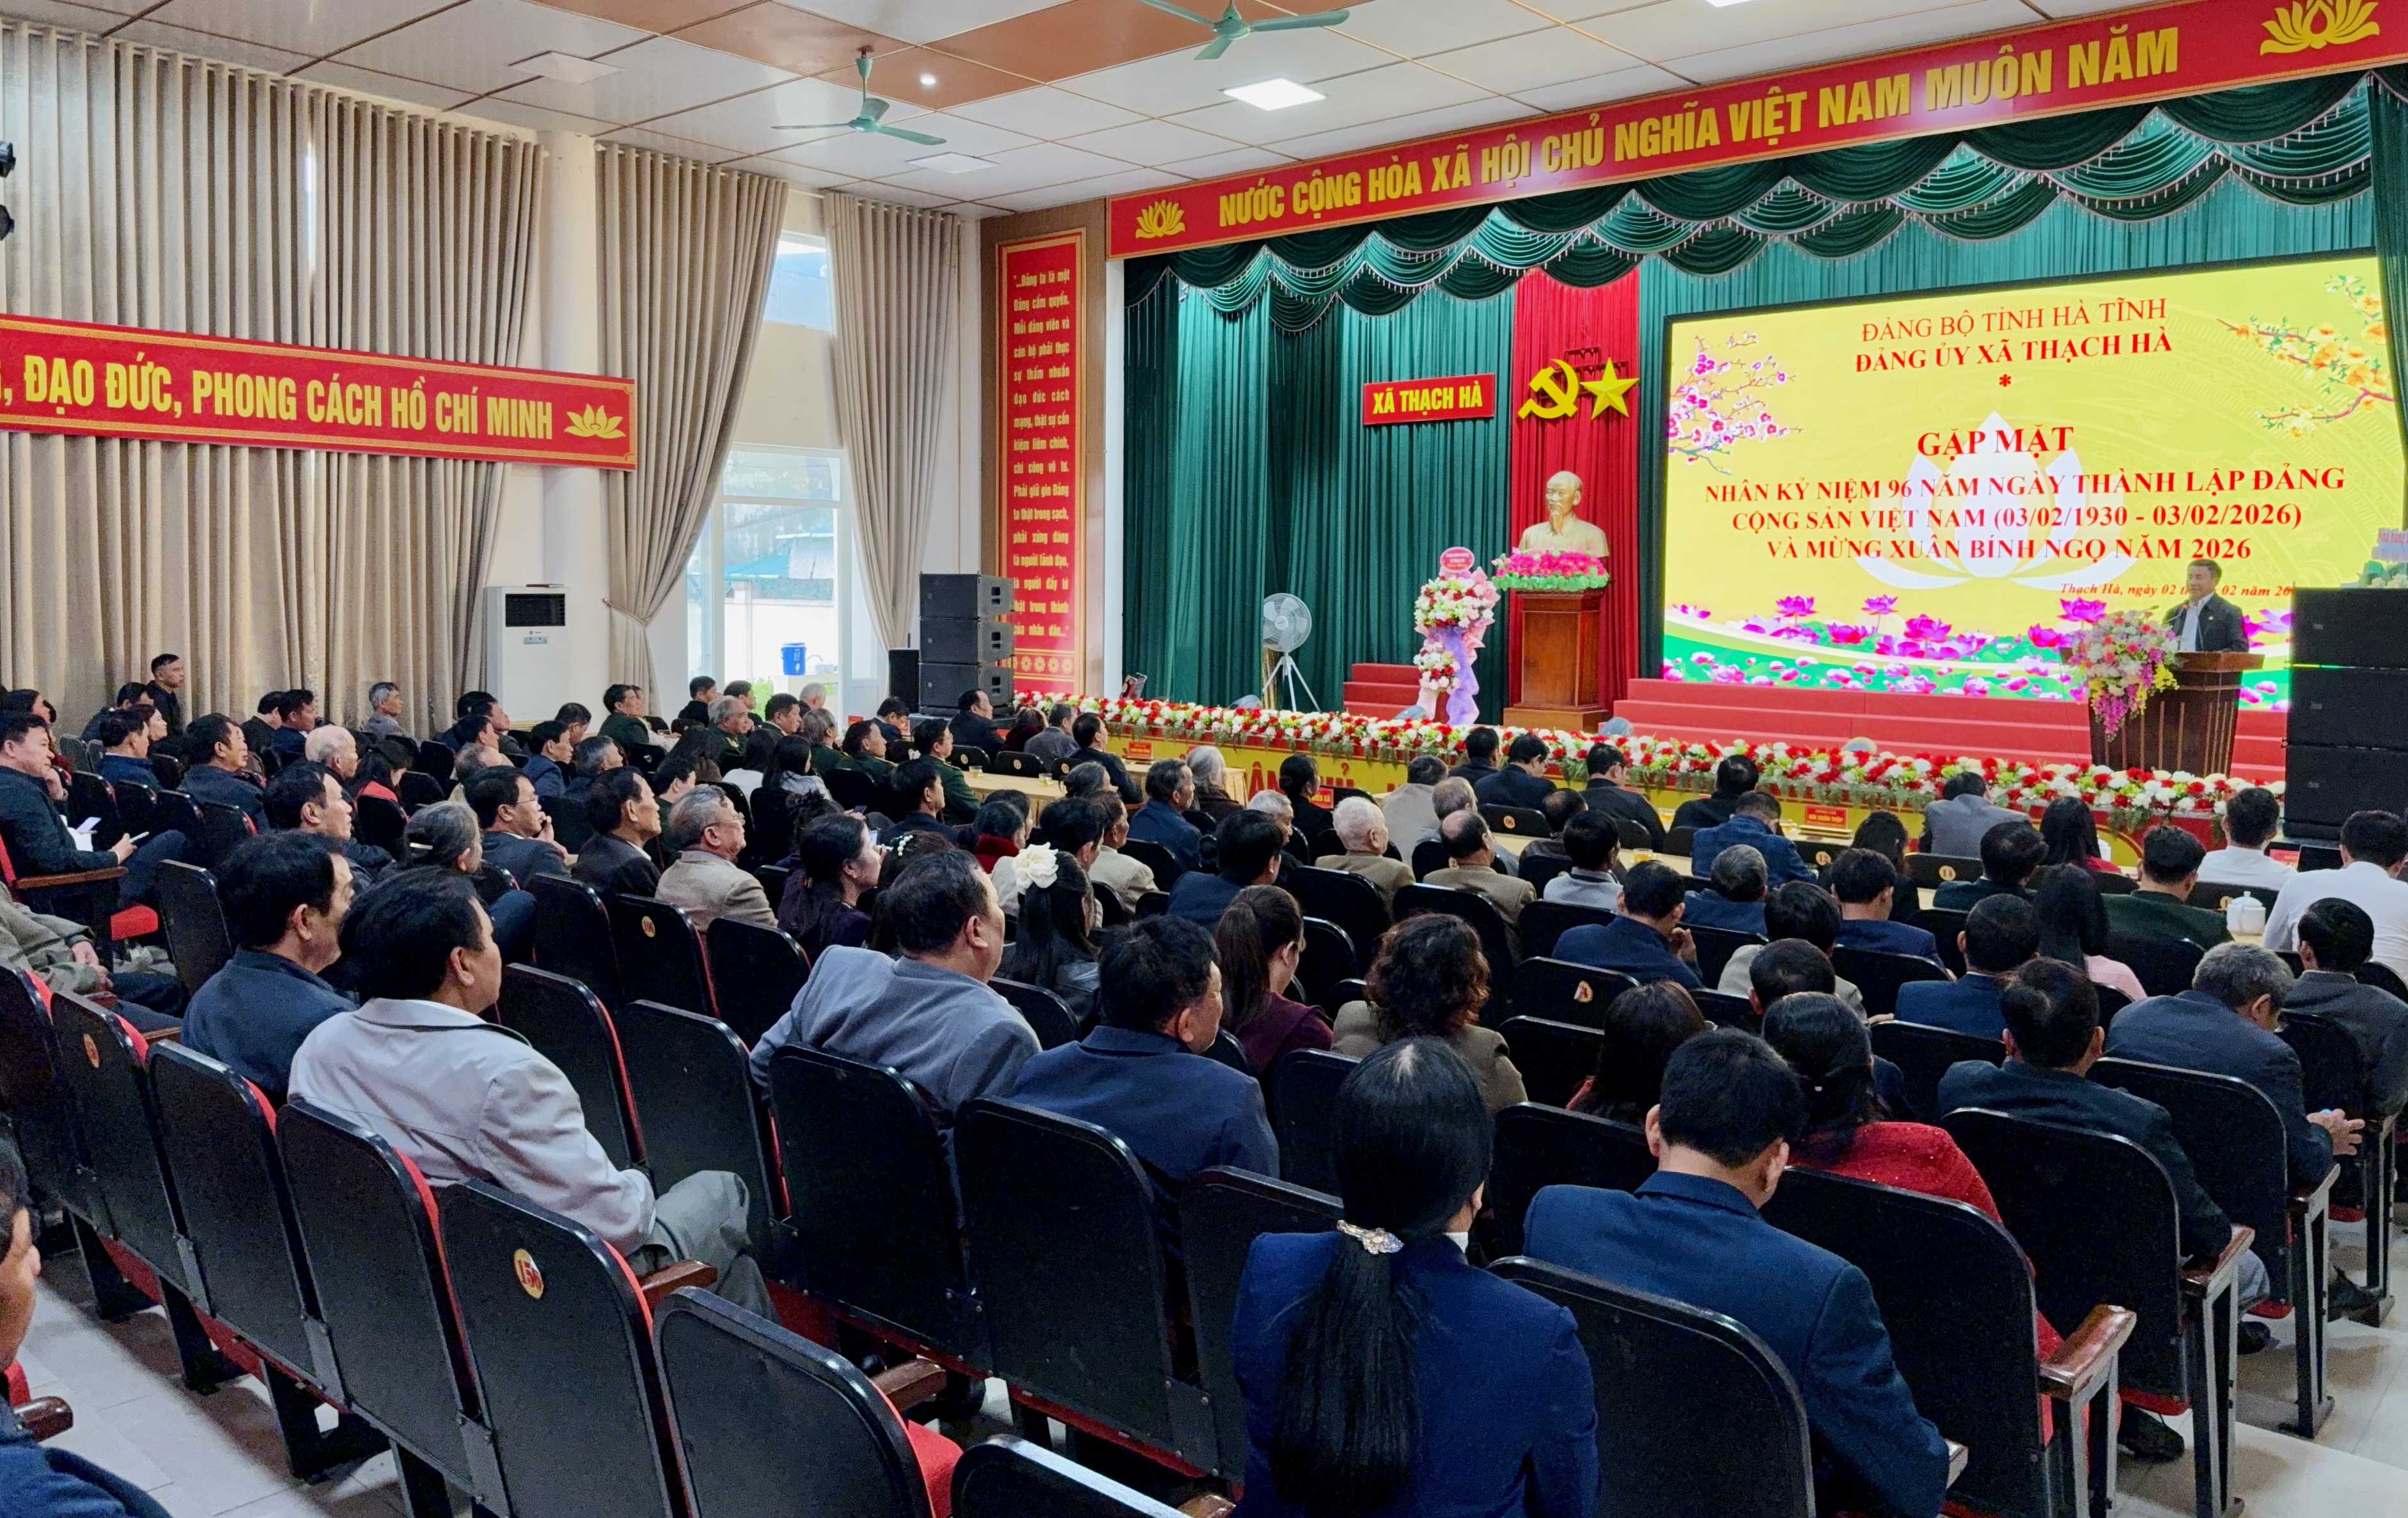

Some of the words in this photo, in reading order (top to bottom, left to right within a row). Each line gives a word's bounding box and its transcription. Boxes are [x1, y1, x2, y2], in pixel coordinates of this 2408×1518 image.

[1219, 176, 1285, 227] NƯỚC
[1292, 168, 1362, 220] CỘNG
[1368, 155, 1422, 204] HÒA
[1431, 144, 1472, 192] XÃ
[1481, 134, 1531, 189] HỘI
[1540, 111, 1604, 173] CHỦ
[1614, 100, 1720, 163] NGHĨA
[1728, 86, 1806, 146] VIỆT
[1818, 74, 1911, 127] NAM
[1925, 44, 2052, 111] MUÔN
[2068, 26, 2179, 84] NĂM
[1040, 272, 1046, 285] ta
[1049, 270, 1055, 283] là
[1058, 269, 1070, 284] một
[1013, 297, 1029, 311] Đảng
[1028, 319, 1044, 333] đảng
[1046, 318, 1059, 331] viên
[1062, 317, 1070, 329] và
[1862, 317, 1932, 342] ĐẢNG
[1940, 309, 1974, 337] BỘ
[1982, 306, 2043, 332] TỈNH
[2052, 299, 2091, 328] HÀ
[2099, 297, 2167, 324] TĨNH
[1028, 344, 1036, 359] bộ
[1039, 341, 1052, 357] phải
[1056, 341, 1070, 356] thực
[1855, 346, 1926, 373] ĐẢNG
[1935, 341, 1970, 367] ỦY
[1977, 339, 2013, 364] XÃ
[2021, 334, 2121, 363] THẠCH
[2131, 326, 2173, 353] HÀ
[1013, 370, 1022, 384] sự
[1027, 365, 1044, 380] thấm
[24, 355, 93, 415] ĐẠO
[106, 351, 182, 419] ĐỨC,
[192, 371, 296, 420] PHONG
[306, 377, 382, 427] CÁCH
[391, 375, 427, 431] HỒ
[435, 385, 478, 435] CHÍ
[487, 398, 553, 440] MINH
[1013, 393, 1027, 407] đạo
[1033, 389, 1046, 403] đức
[1051, 389, 1070, 402] cách
[1373, 387, 1395, 414] XÃ
[1400, 387, 1454, 416] THẠCH
[1459, 380, 1483, 408] HÀ
[1035, 414, 1047, 429] thật
[1048, 414, 1056, 428] sự
[1058, 410, 1070, 425] cần
[1013, 439, 1029, 453] kiệm
[1033, 437, 1047, 450] liêm
[1917, 428, 1985, 461] GẶP
[1994, 424, 2074, 459] MẶT
[1013, 462, 1024, 474] chí
[1028, 461, 1044, 474] công
[1048, 460, 1056, 473] vô
[1013, 483, 1028, 497] Phải
[1029, 483, 1039, 498] giữ
[1041, 484, 1051, 497] gìn
[1052, 482, 1069, 497] Đảng
[1705, 479, 1769, 503] NHÂN
[1777, 477, 1810, 501] KỶ
[1817, 478, 1880, 503] NIỆM
[1888, 479, 1912, 498] 96
[1920, 474, 1979, 497] NĂM
[1989, 468, 2065, 496] NGÀY
[2072, 467, 2175, 494] THÀNH
[2185, 467, 2244, 497] LẬP
[2251, 462, 2345, 491] ĐẢNG
[1013, 508, 1020, 520] ta
[1021, 508, 1033, 522] thật
[1034, 508, 1051, 521] trong
[1733, 510, 1799, 535] CỘNG
[1806, 506, 1853, 529] SẢN
[1860, 507, 1919, 533] VIỆT
[1926, 508, 1985, 528] NAM
[1994, 503, 2128, 530] (03/02/1930
[2152, 502, 2302, 529] 03/02/2026)
[1013, 529, 1028, 545] phải
[1032, 529, 1048, 545] xứng
[1767, 536, 1797, 559] VÀ
[1806, 535, 1882, 559] MỪNG
[1891, 535, 1960, 559] XUÂN
[1969, 533, 2035, 559] BÍNH
[2045, 538, 2107, 564] NGỌ
[2115, 533, 2182, 559] NĂM
[2191, 538, 2251, 559] 2026
[1013, 554, 1019, 567] là
[1020, 552, 1038, 568] người
[1040, 552, 1053, 566] lãnh
[1024, 575, 1042, 591] người
[1046, 575, 1058, 591] đầy
[1062, 577, 1069, 590] tớ
[2060, 583, 2097, 595] Thạch
[2101, 583, 2123, 596] Hà,
[2127, 583, 2158, 597] ngày
[2161, 584, 2177, 595] 02
[2221, 584, 2237, 596] 02
[2240, 584, 2271, 596] năm
[2274, 584, 2294, 597] 20
[1029, 600, 1046, 614] trung
[1051, 600, 1068, 613] thành
[1029, 623, 1045, 636] nhân
[517, 1258, 542, 1291] 156
